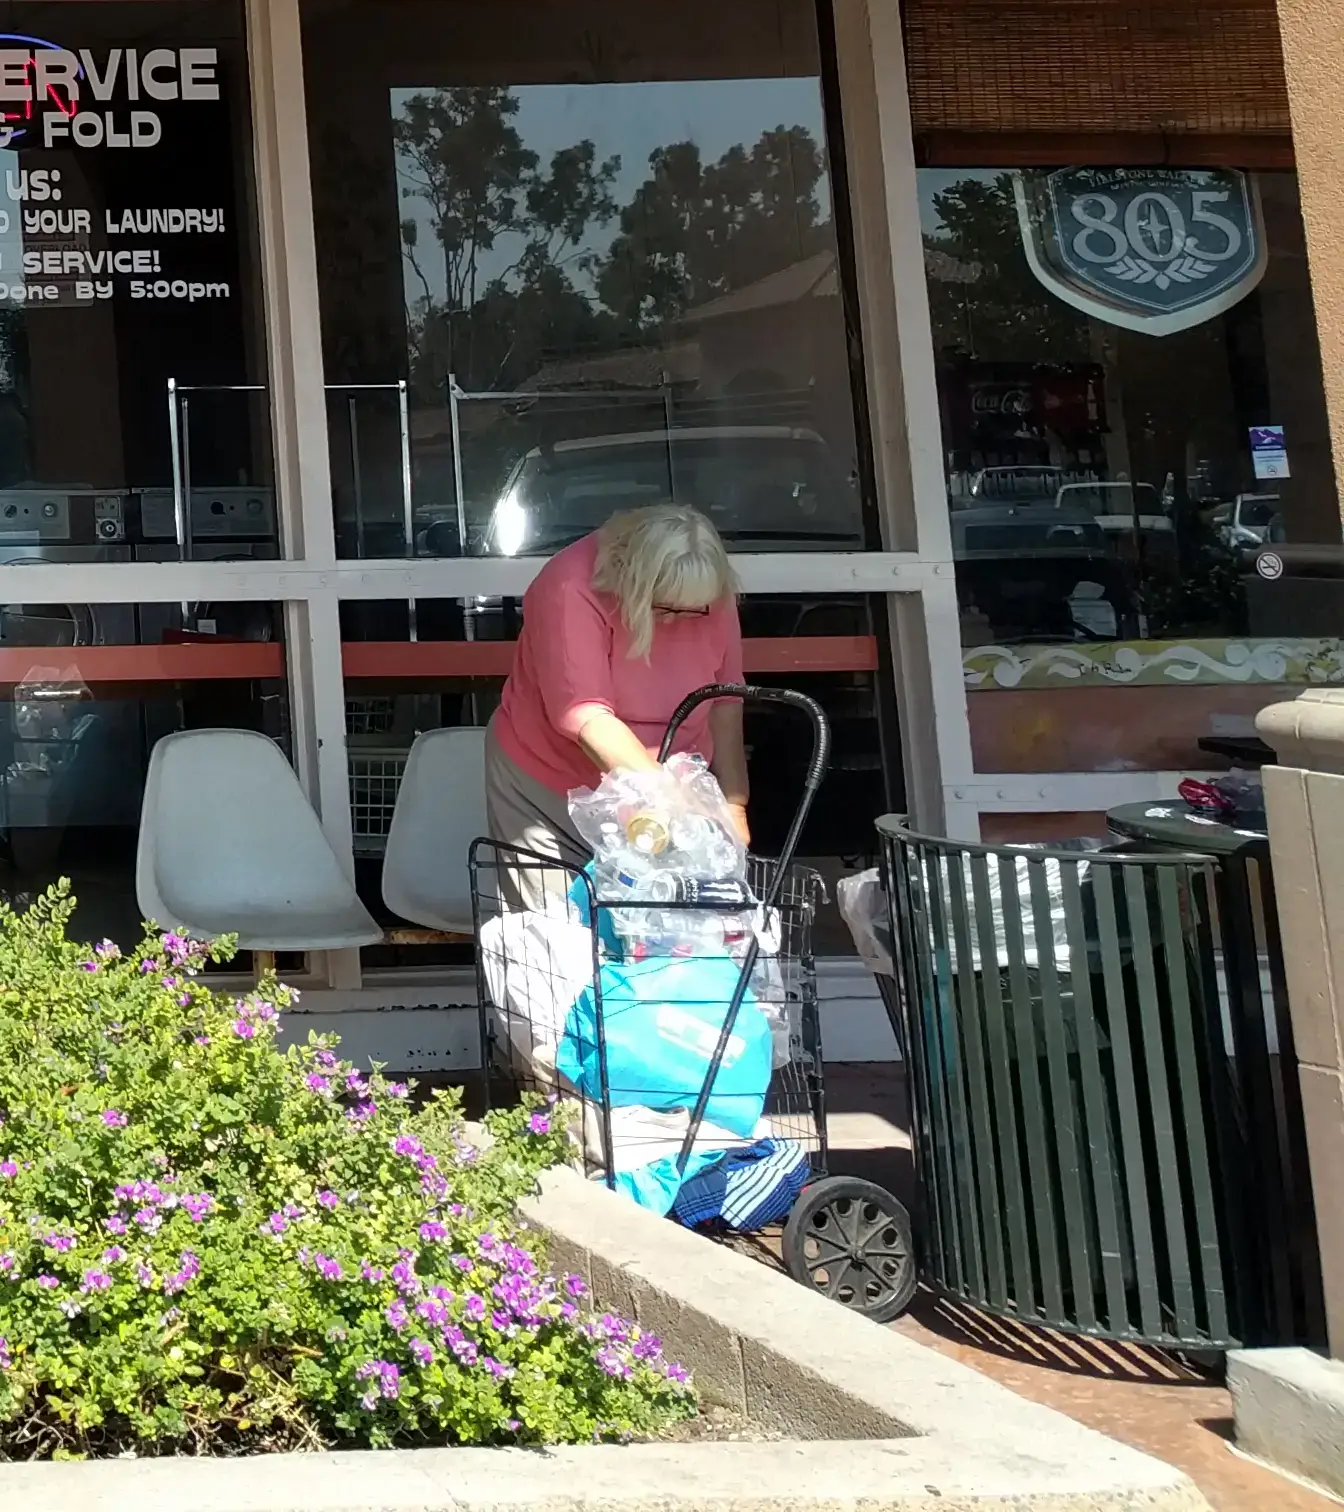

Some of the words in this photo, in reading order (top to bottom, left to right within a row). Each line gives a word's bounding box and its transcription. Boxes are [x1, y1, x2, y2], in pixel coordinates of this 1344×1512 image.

[42, 111, 162, 148] FOLD
[6, 169, 62, 201] us:
[23, 209, 91, 234] YOUR
[105, 208, 226, 234] LAUNDRY!
[1070, 191, 1242, 264] 805
[22, 250, 162, 275] SERVICE!
[75, 280, 114, 299] BY
[130, 280, 230, 302] 5:00pm
